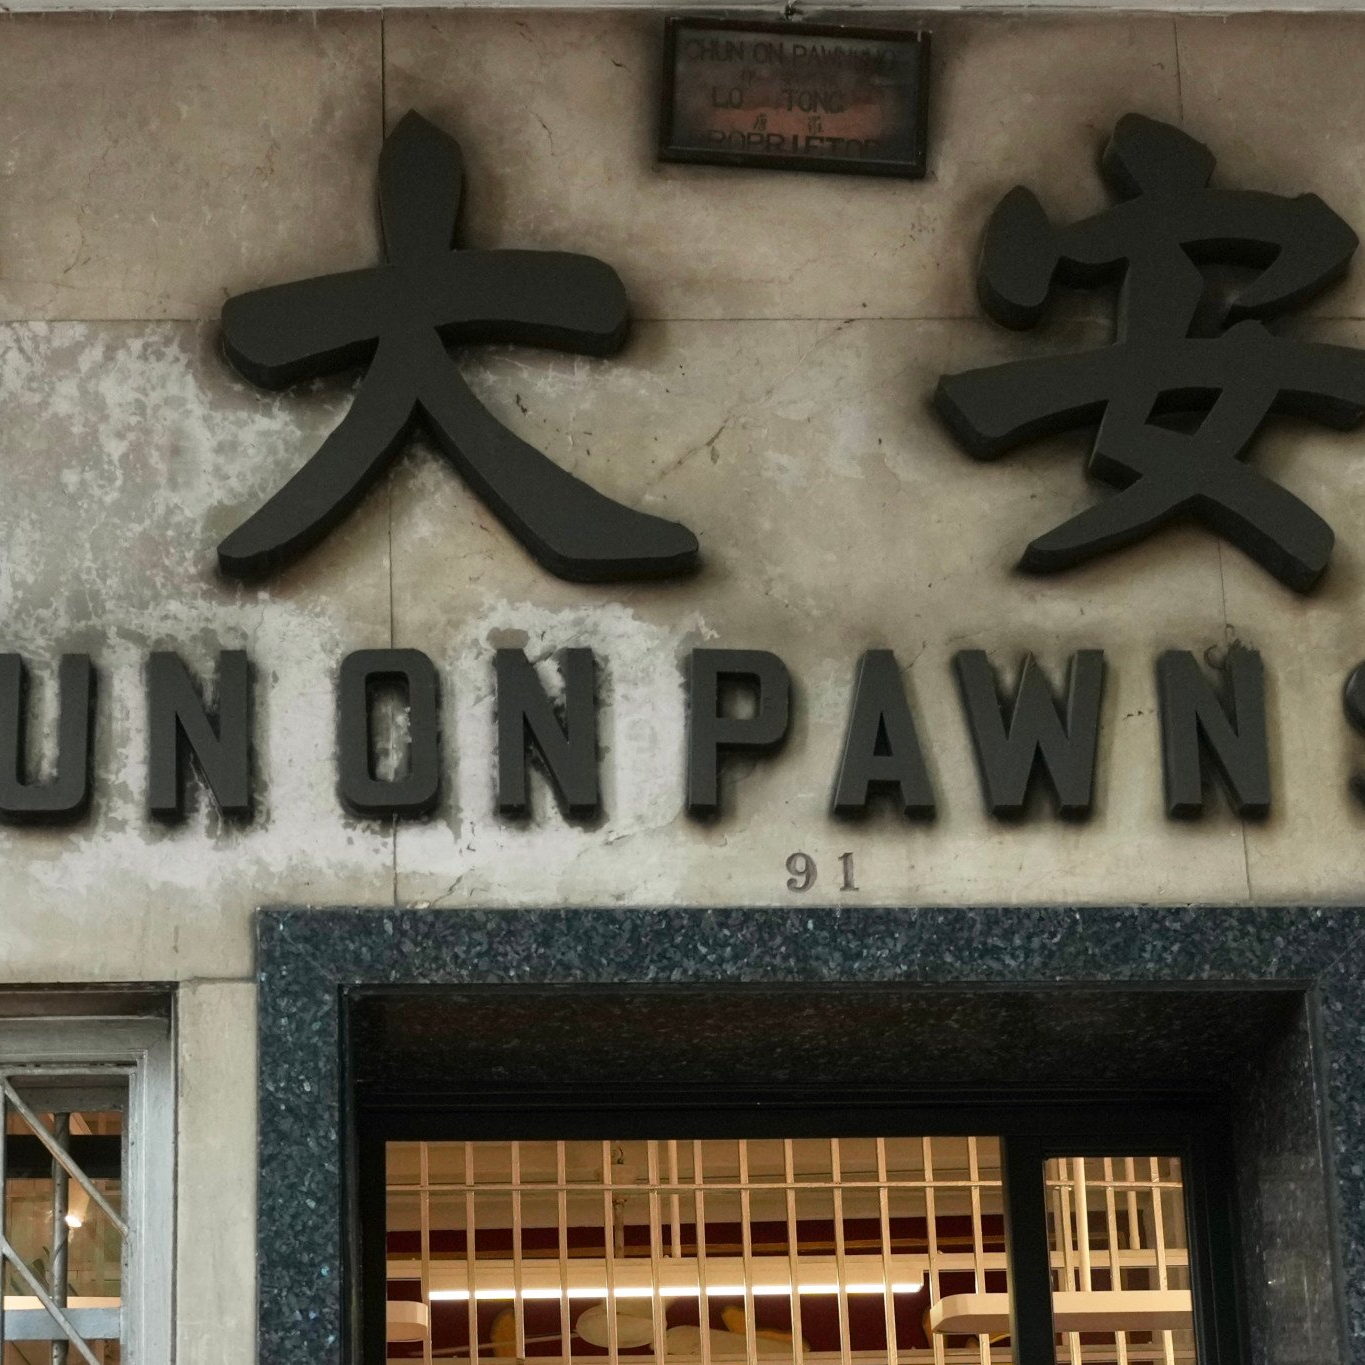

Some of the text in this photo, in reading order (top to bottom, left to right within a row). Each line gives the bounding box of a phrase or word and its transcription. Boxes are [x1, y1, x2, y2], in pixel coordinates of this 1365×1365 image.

[338, 646, 605, 828] ON
[684, 646, 1273, 829] PAWN
[785, 851, 860, 893] 91
